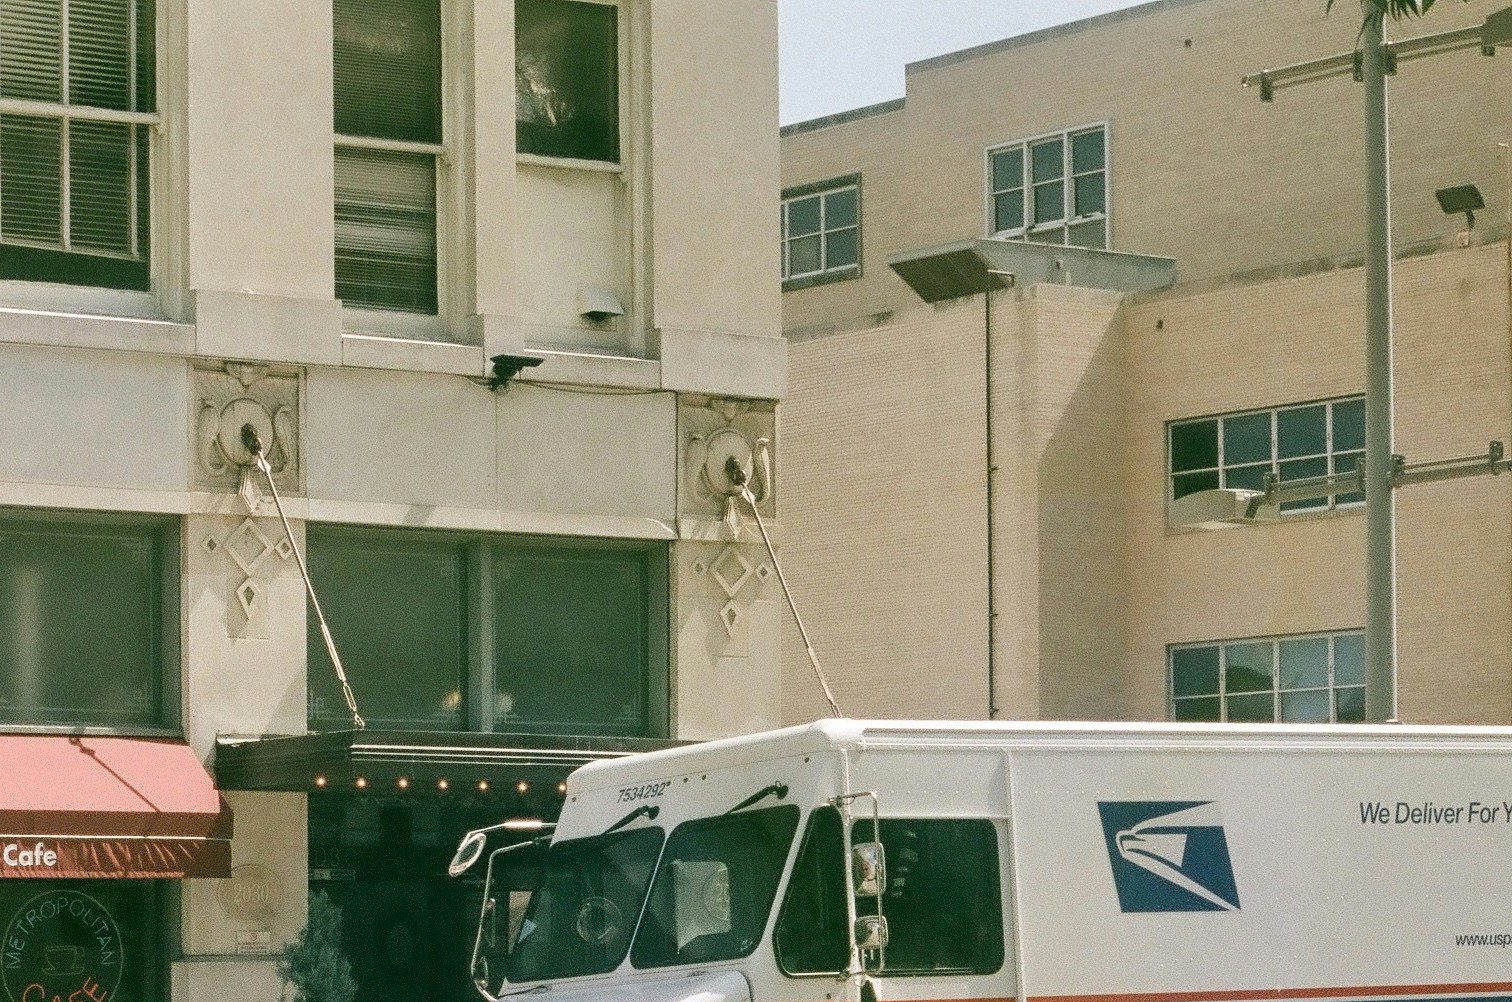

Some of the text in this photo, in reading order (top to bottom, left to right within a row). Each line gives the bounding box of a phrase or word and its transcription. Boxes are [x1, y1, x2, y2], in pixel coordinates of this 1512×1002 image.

[617, 782, 666, 803] 7534292
[1360, 801, 1390, 824] We
[1395, 801, 1464, 824] Deliver
[1467, 801, 1500, 823] For
[3, 842, 57, 867] Cafe
[5, 897, 115, 970] METROPOLITAN
[1455, 934, 1512, 949] www.usp
